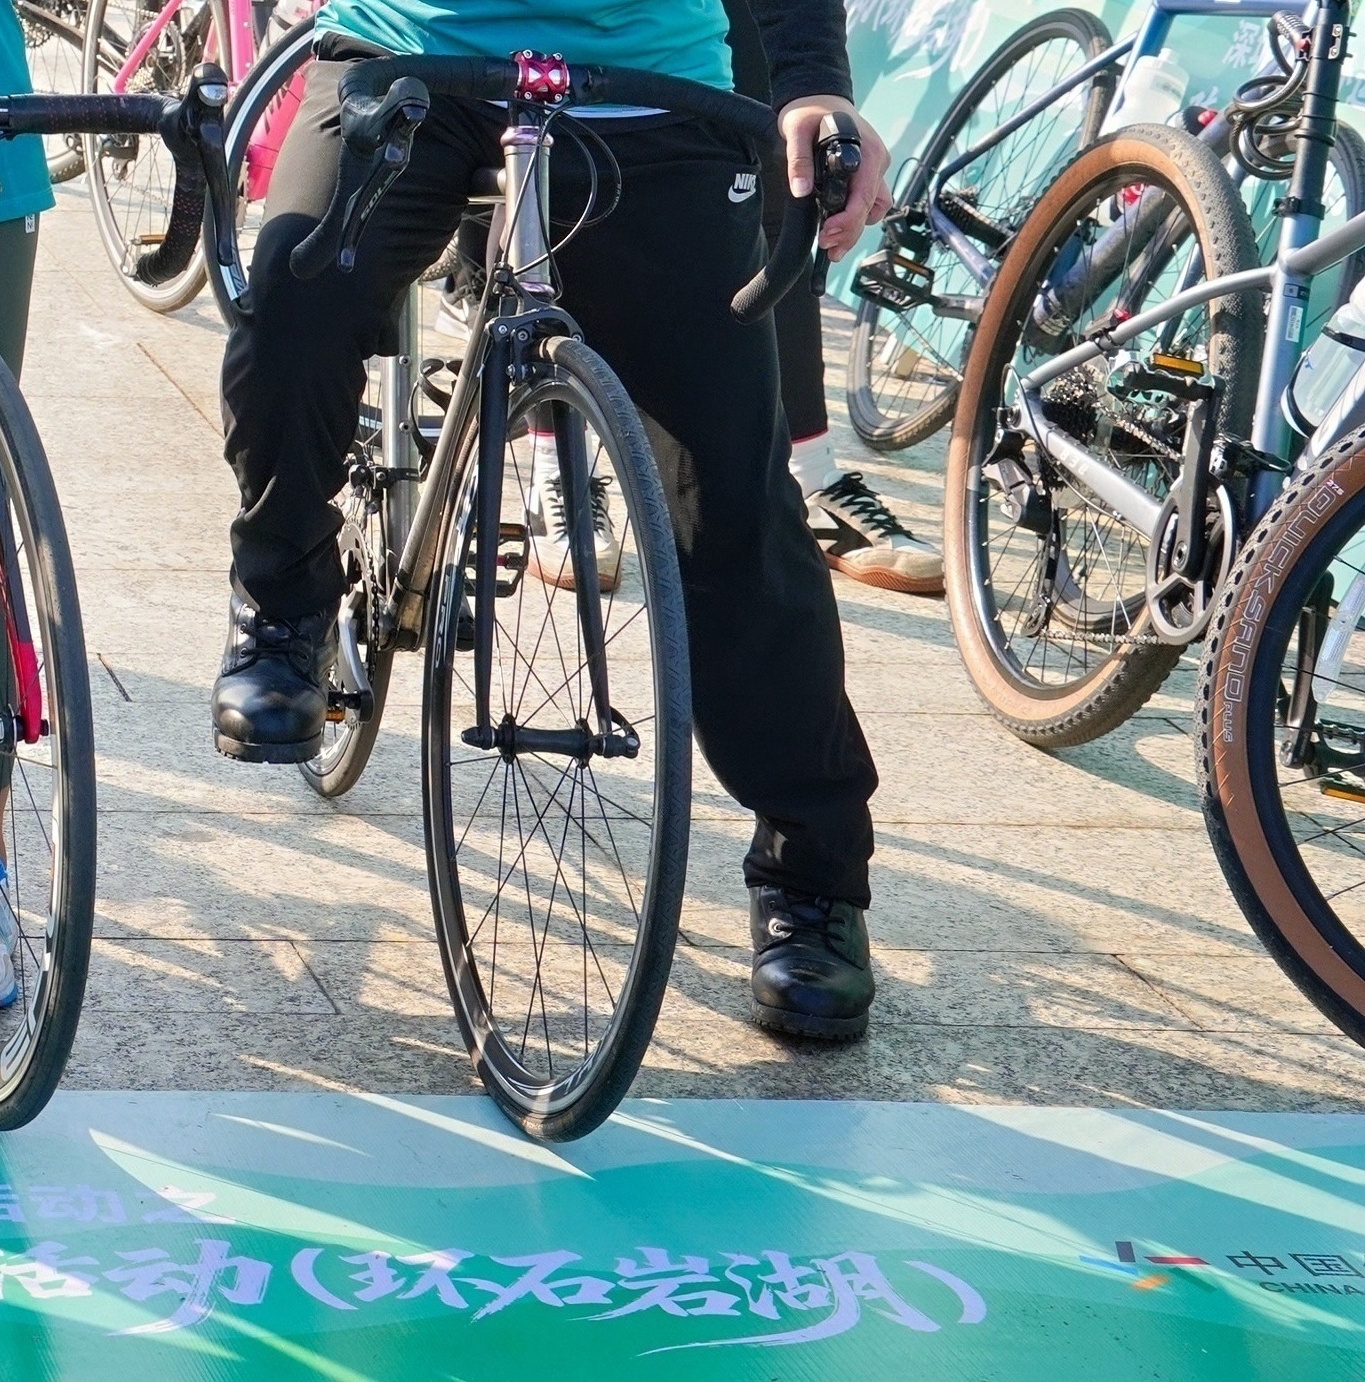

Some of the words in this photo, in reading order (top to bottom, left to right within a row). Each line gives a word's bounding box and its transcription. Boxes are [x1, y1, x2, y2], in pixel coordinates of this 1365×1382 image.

[1253, 486, 1338, 595] QUICK
[1223, 590, 1267, 703] SAND
[1226, 1250, 1365, 1278] 中国
